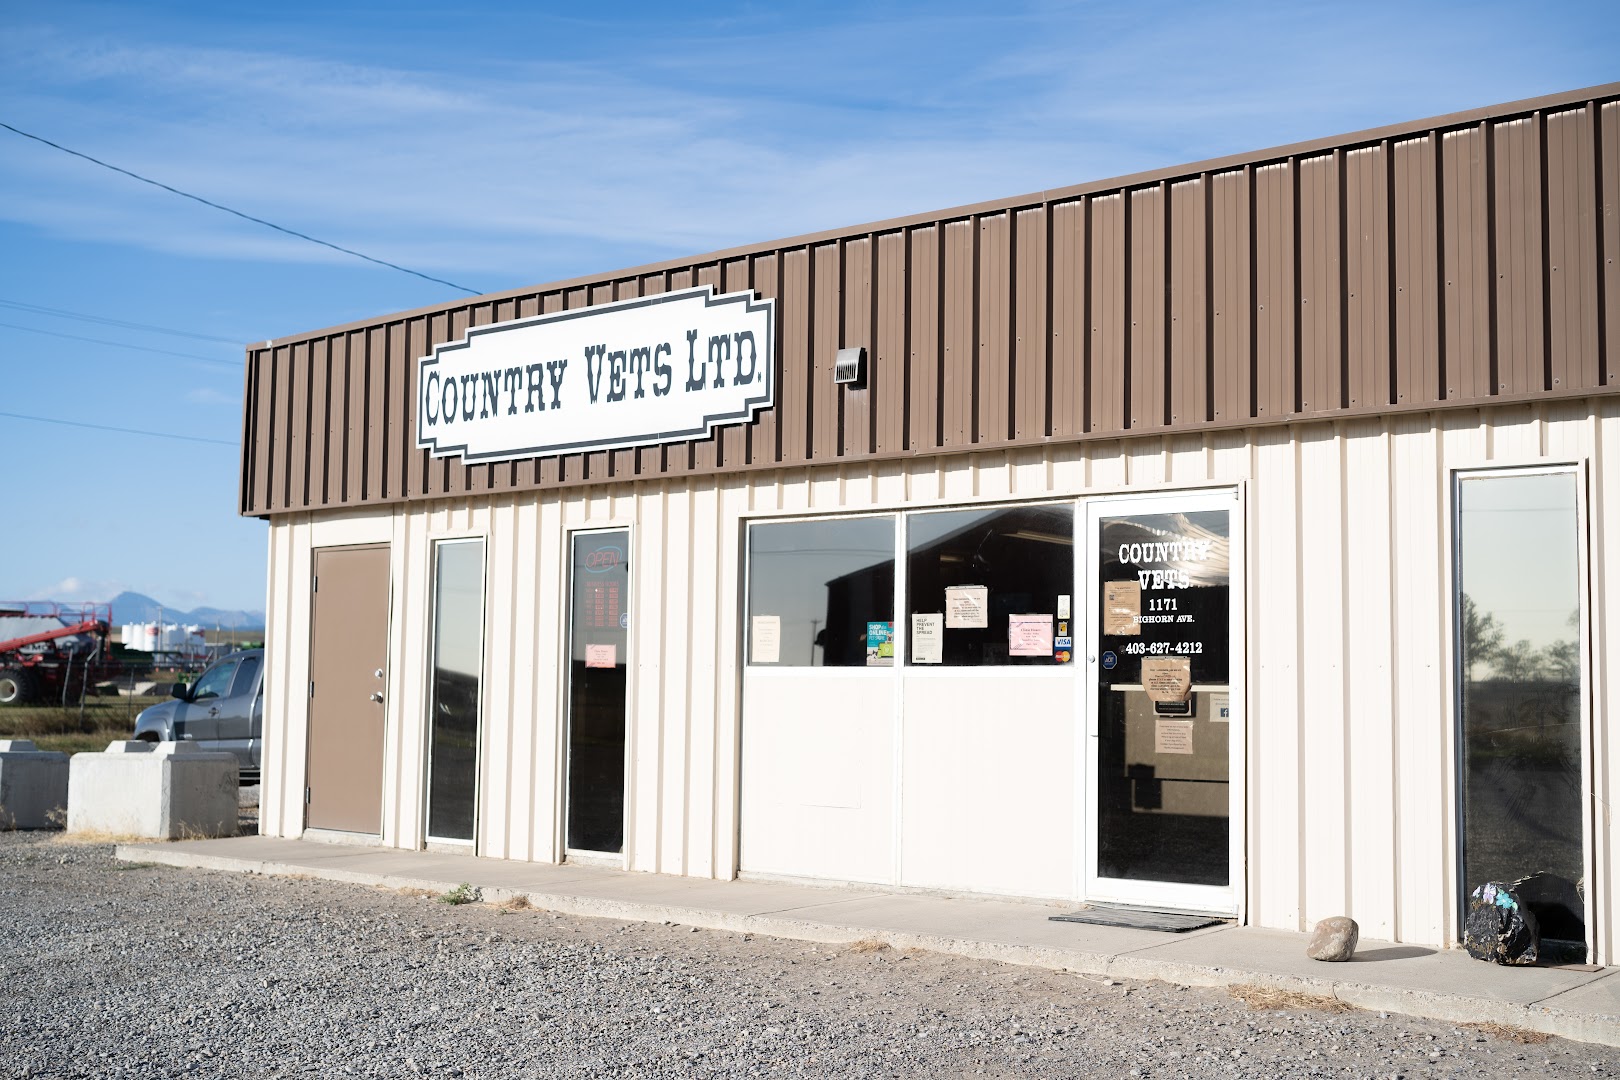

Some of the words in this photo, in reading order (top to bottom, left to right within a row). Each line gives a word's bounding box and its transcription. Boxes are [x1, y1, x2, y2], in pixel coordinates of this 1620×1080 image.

[425, 359, 568, 426] COUNTRY
[584, 342, 672, 405] VETS
[685, 329, 762, 392] LTD.
[586, 552, 620, 568] OPEN
[1118, 541, 1210, 564] COUNTRY
[1138, 569, 1190, 590] VETS
[1149, 598, 1178, 611] 1171
[1133, 615, 1174, 624] BIGHORN
[1176, 614, 1195, 623] AVE.
[1125, 642, 1203, 655] 403-627-4212
